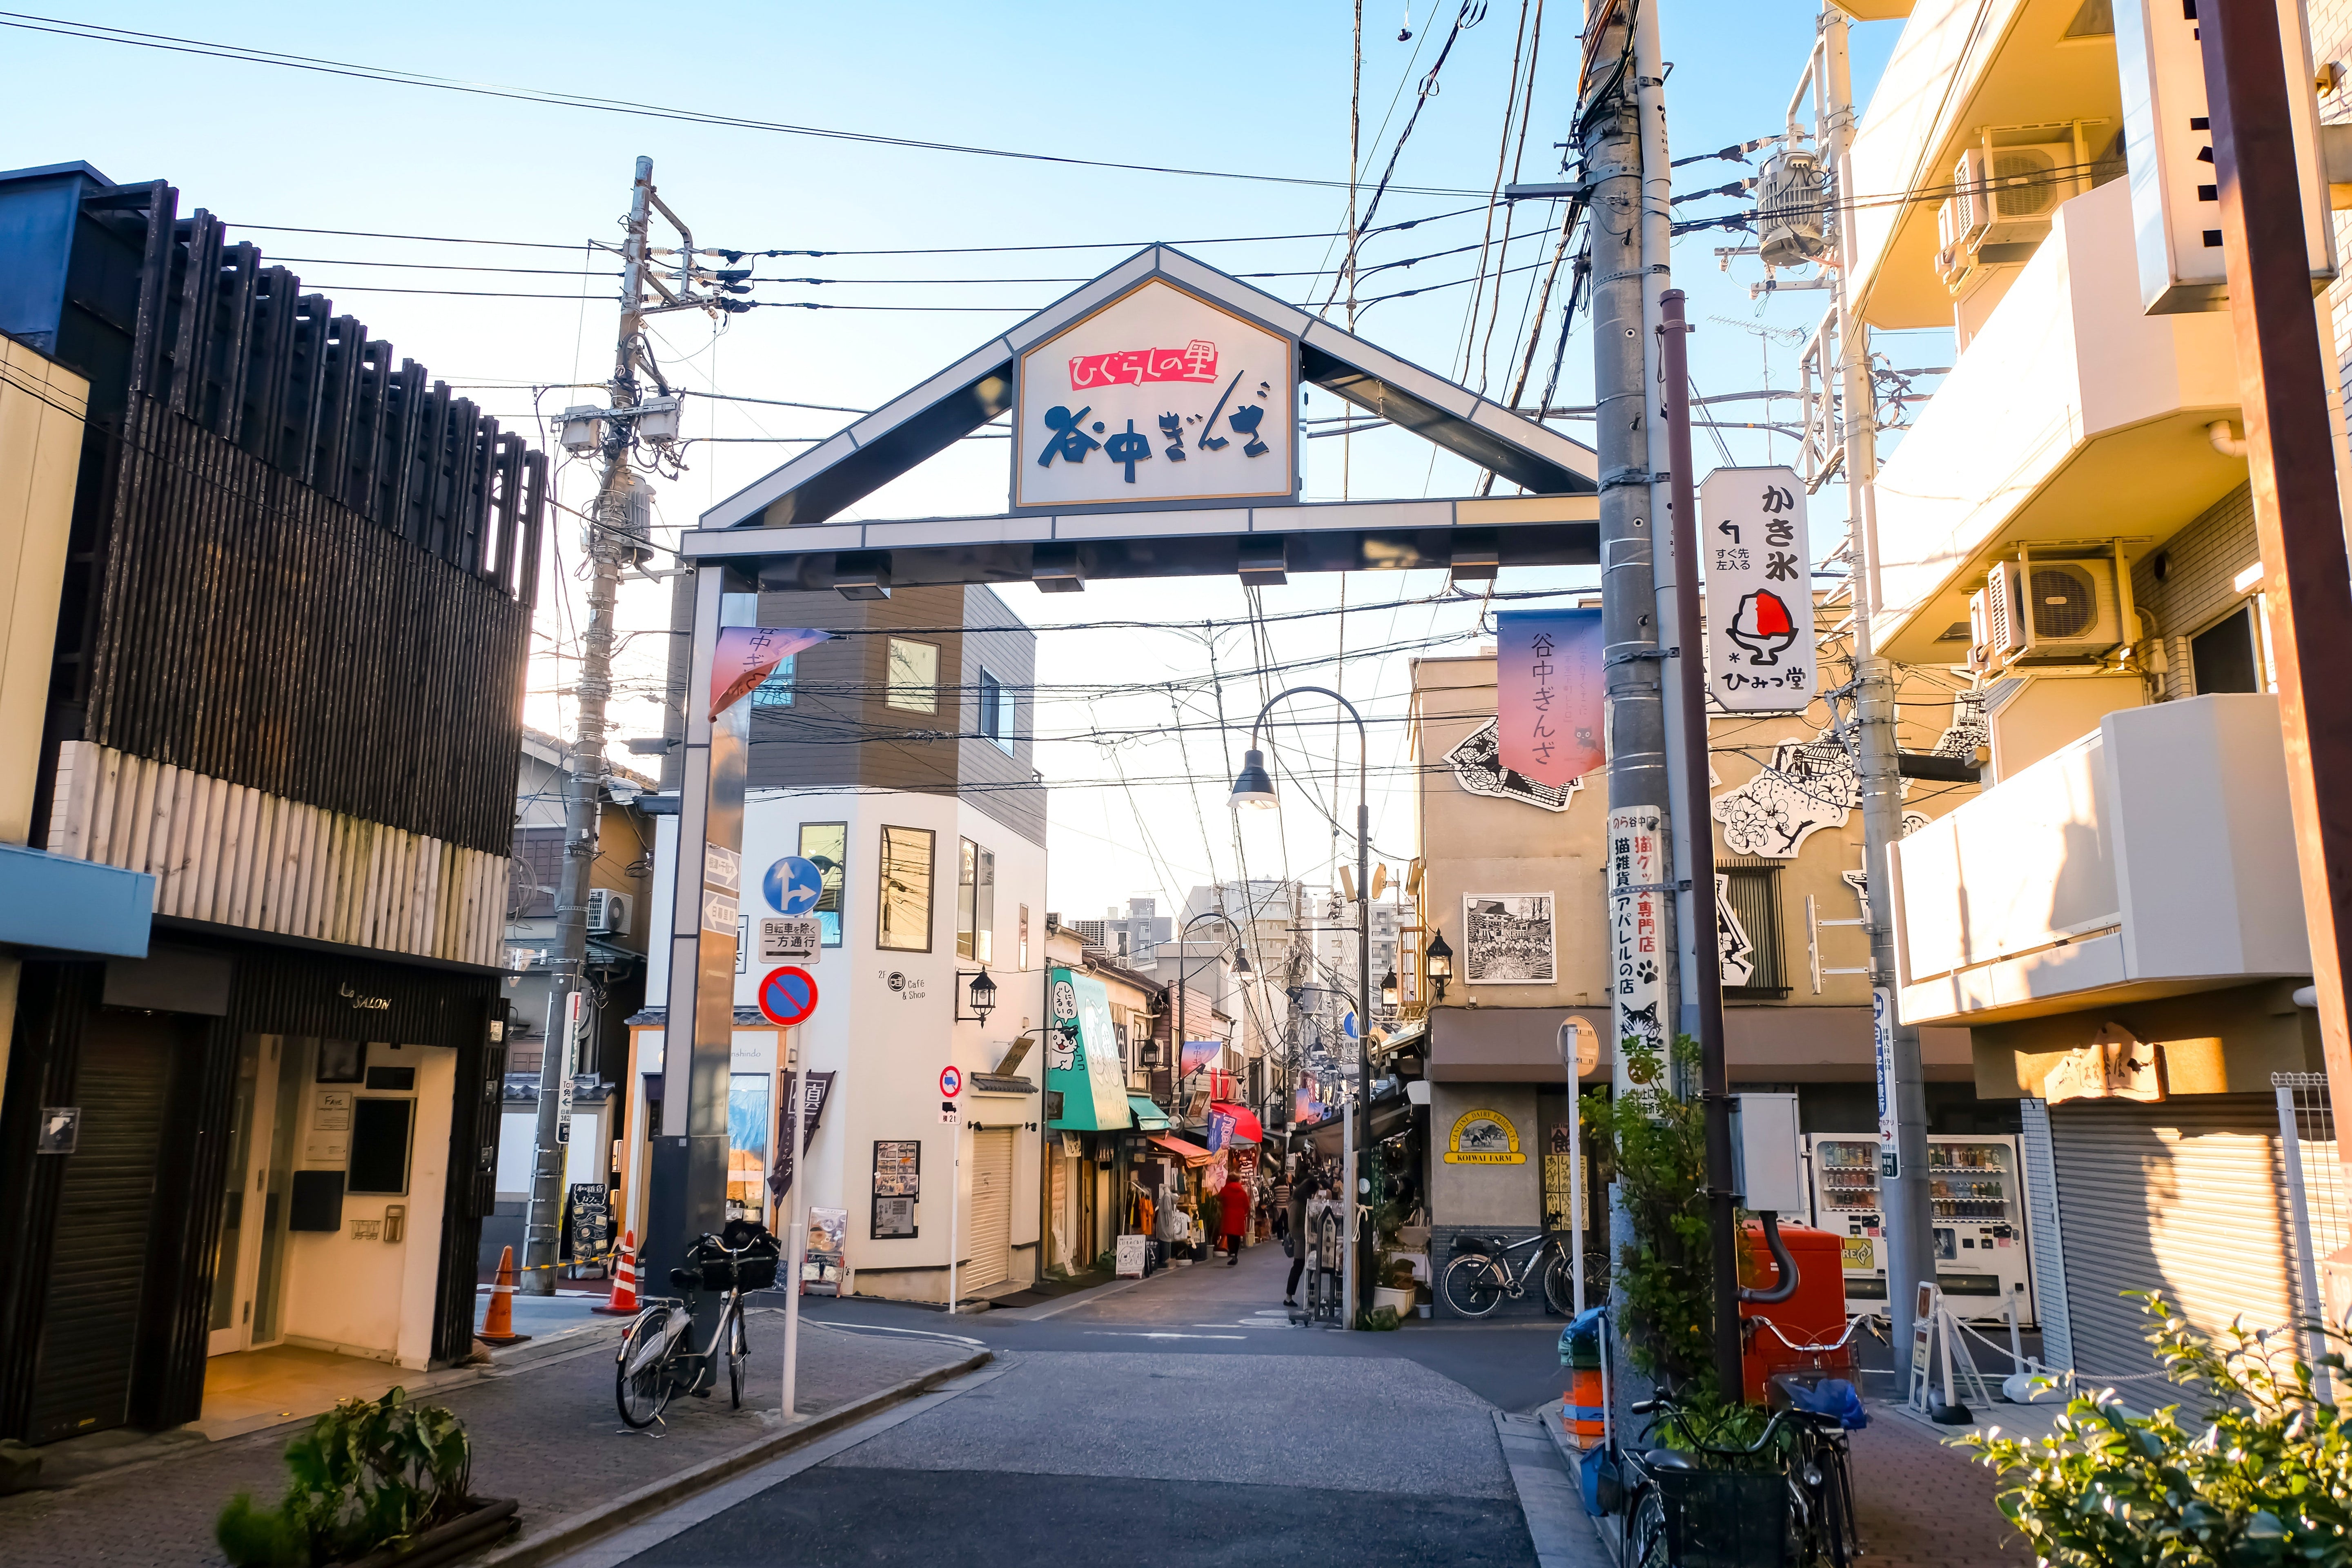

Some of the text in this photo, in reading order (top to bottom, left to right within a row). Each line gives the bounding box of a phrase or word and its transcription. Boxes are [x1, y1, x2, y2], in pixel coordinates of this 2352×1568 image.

[1073, 340, 1218, 387] ひぐらしの里
[1038, 370, 1270, 483] 谷中ぎんざ
[1762, 485, 1799, 582] かき氷
[1715, 548, 1750, 559] すぐ先
[1716, 560, 1751, 571] 左入る
[1721, 667, 1806, 690] ひみつ堂
[1531, 633, 1555, 765] 谷中ぎんざ
[765, 922, 815, 934] 自転車を除く
[764, 936, 815, 947] 一方通行
[878, 970, 886, 979] 2F
[908, 979, 924, 989] Café
[353, 995, 392, 1010] SALON
[902, 991, 926, 1000] & Shop
[1056, 987, 1064, 1014] ぐるい
[1064, 986, 1073, 1016] しにもの
